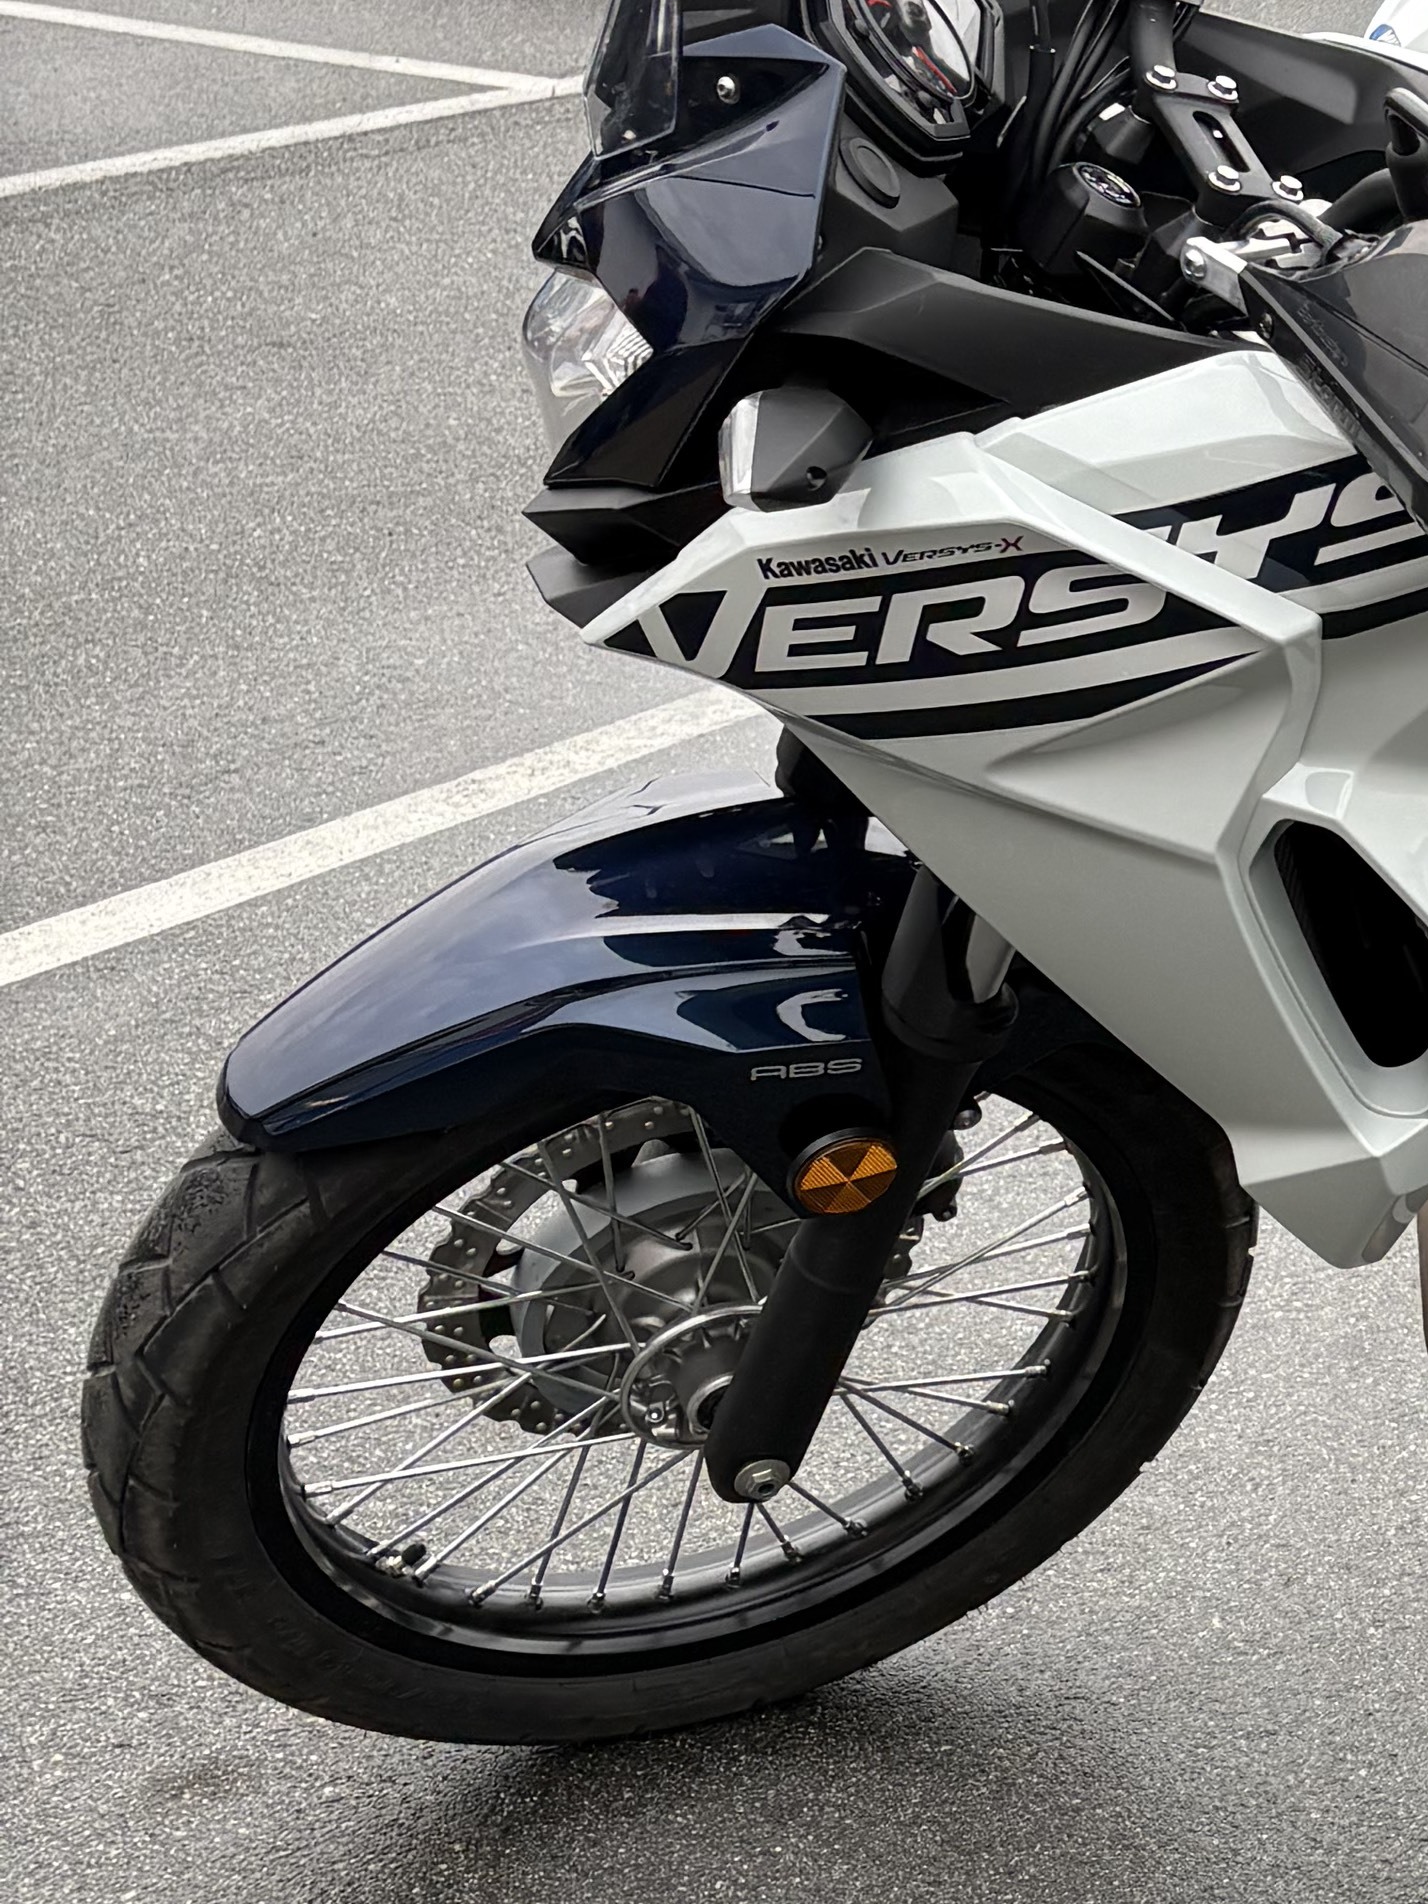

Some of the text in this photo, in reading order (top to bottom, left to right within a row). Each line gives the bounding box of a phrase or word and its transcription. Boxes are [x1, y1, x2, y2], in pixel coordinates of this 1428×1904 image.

[757, 535, 1024, 580] Kawasaki VERSYS-X
[750, 1058, 862, 1081] ABS
